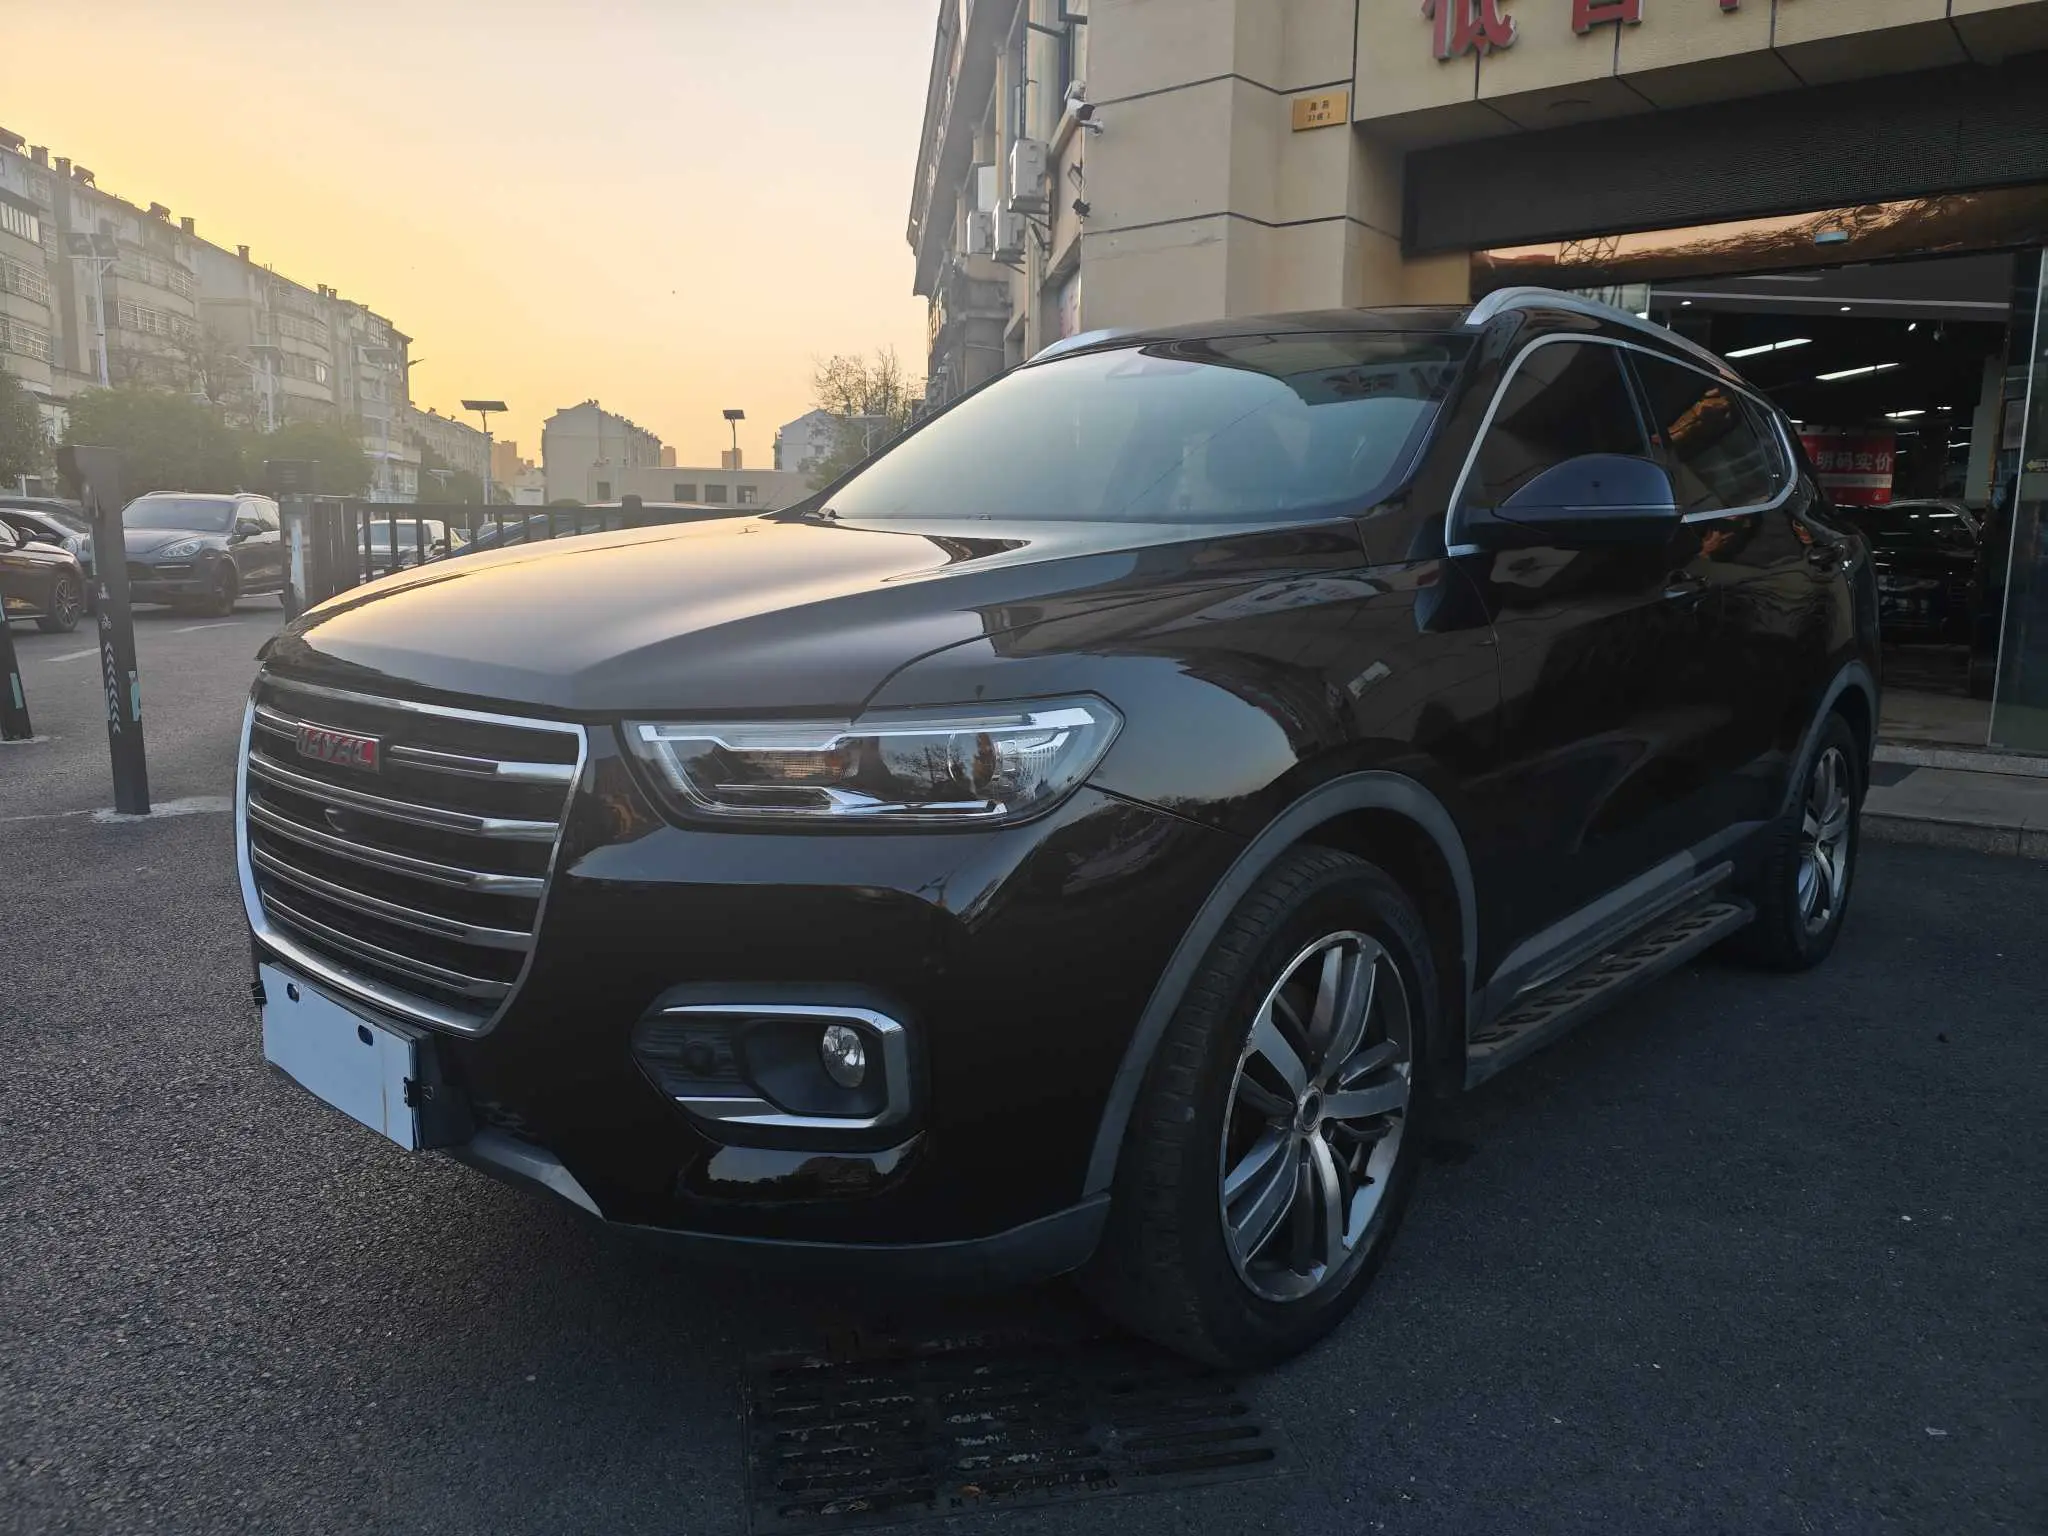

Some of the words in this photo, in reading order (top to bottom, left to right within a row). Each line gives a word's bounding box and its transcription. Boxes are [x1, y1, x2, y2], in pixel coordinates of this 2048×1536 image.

[1809, 451, 1893, 472] 明码实价
[297, 727, 373, 766] HAVAL
